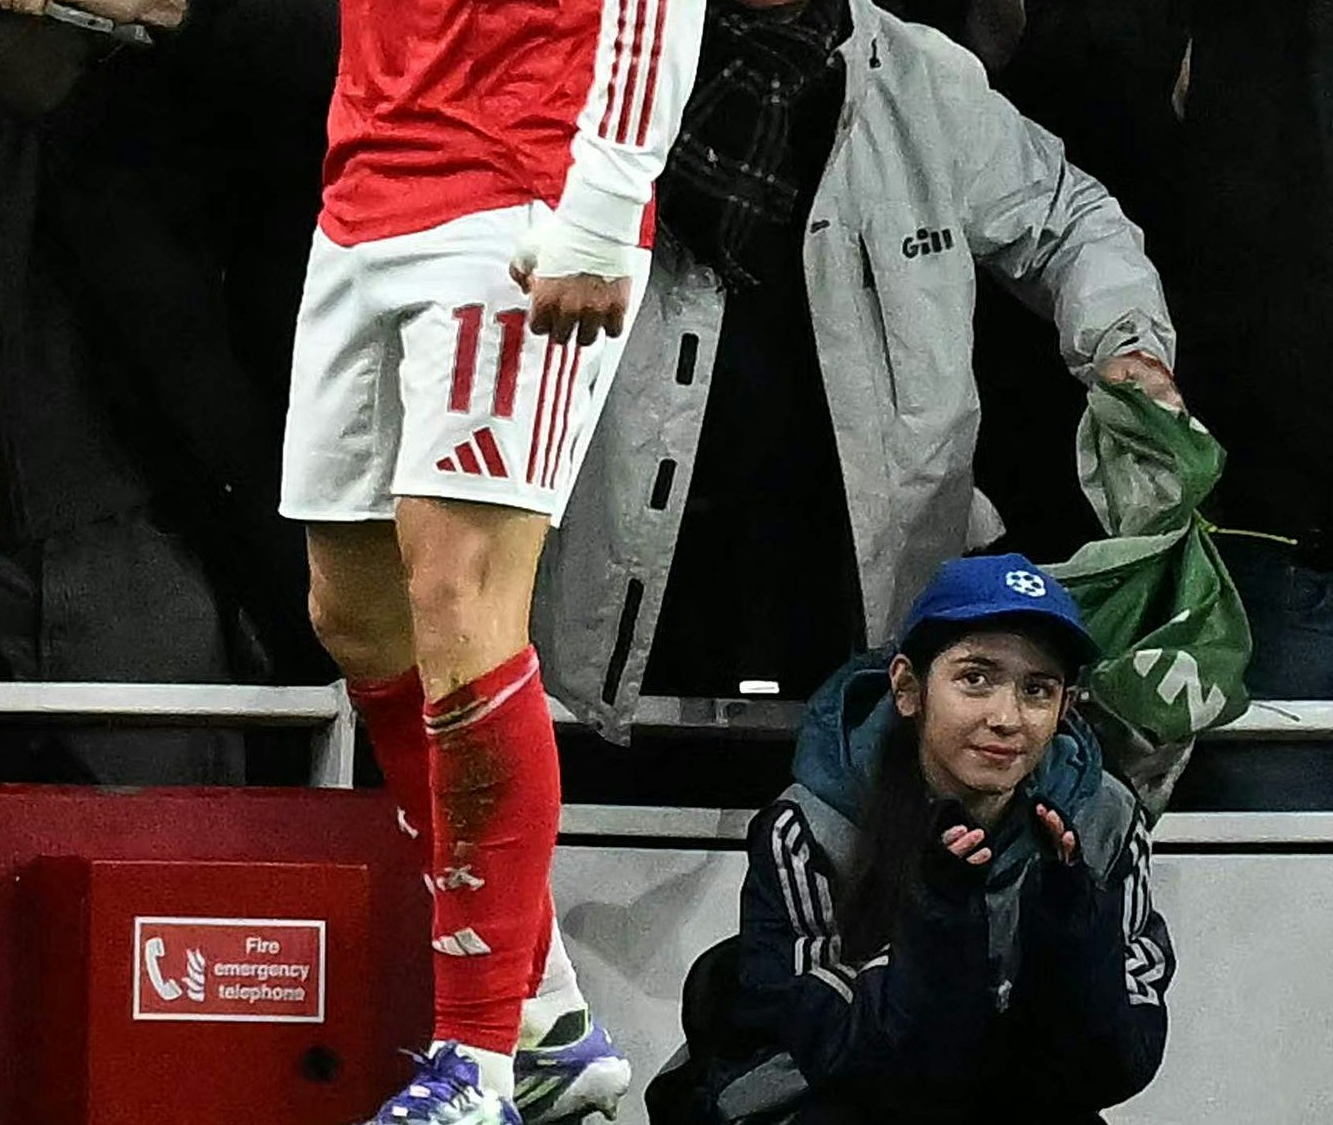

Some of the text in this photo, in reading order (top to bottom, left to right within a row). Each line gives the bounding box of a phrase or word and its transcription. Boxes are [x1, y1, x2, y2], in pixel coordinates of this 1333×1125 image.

[902, 228, 954, 259] Gill
[447, 303, 528, 418] 11
[246, 937, 280, 954] Fire
[214, 961, 311, 983] emergency
[218, 983, 306, 1003] telephone
